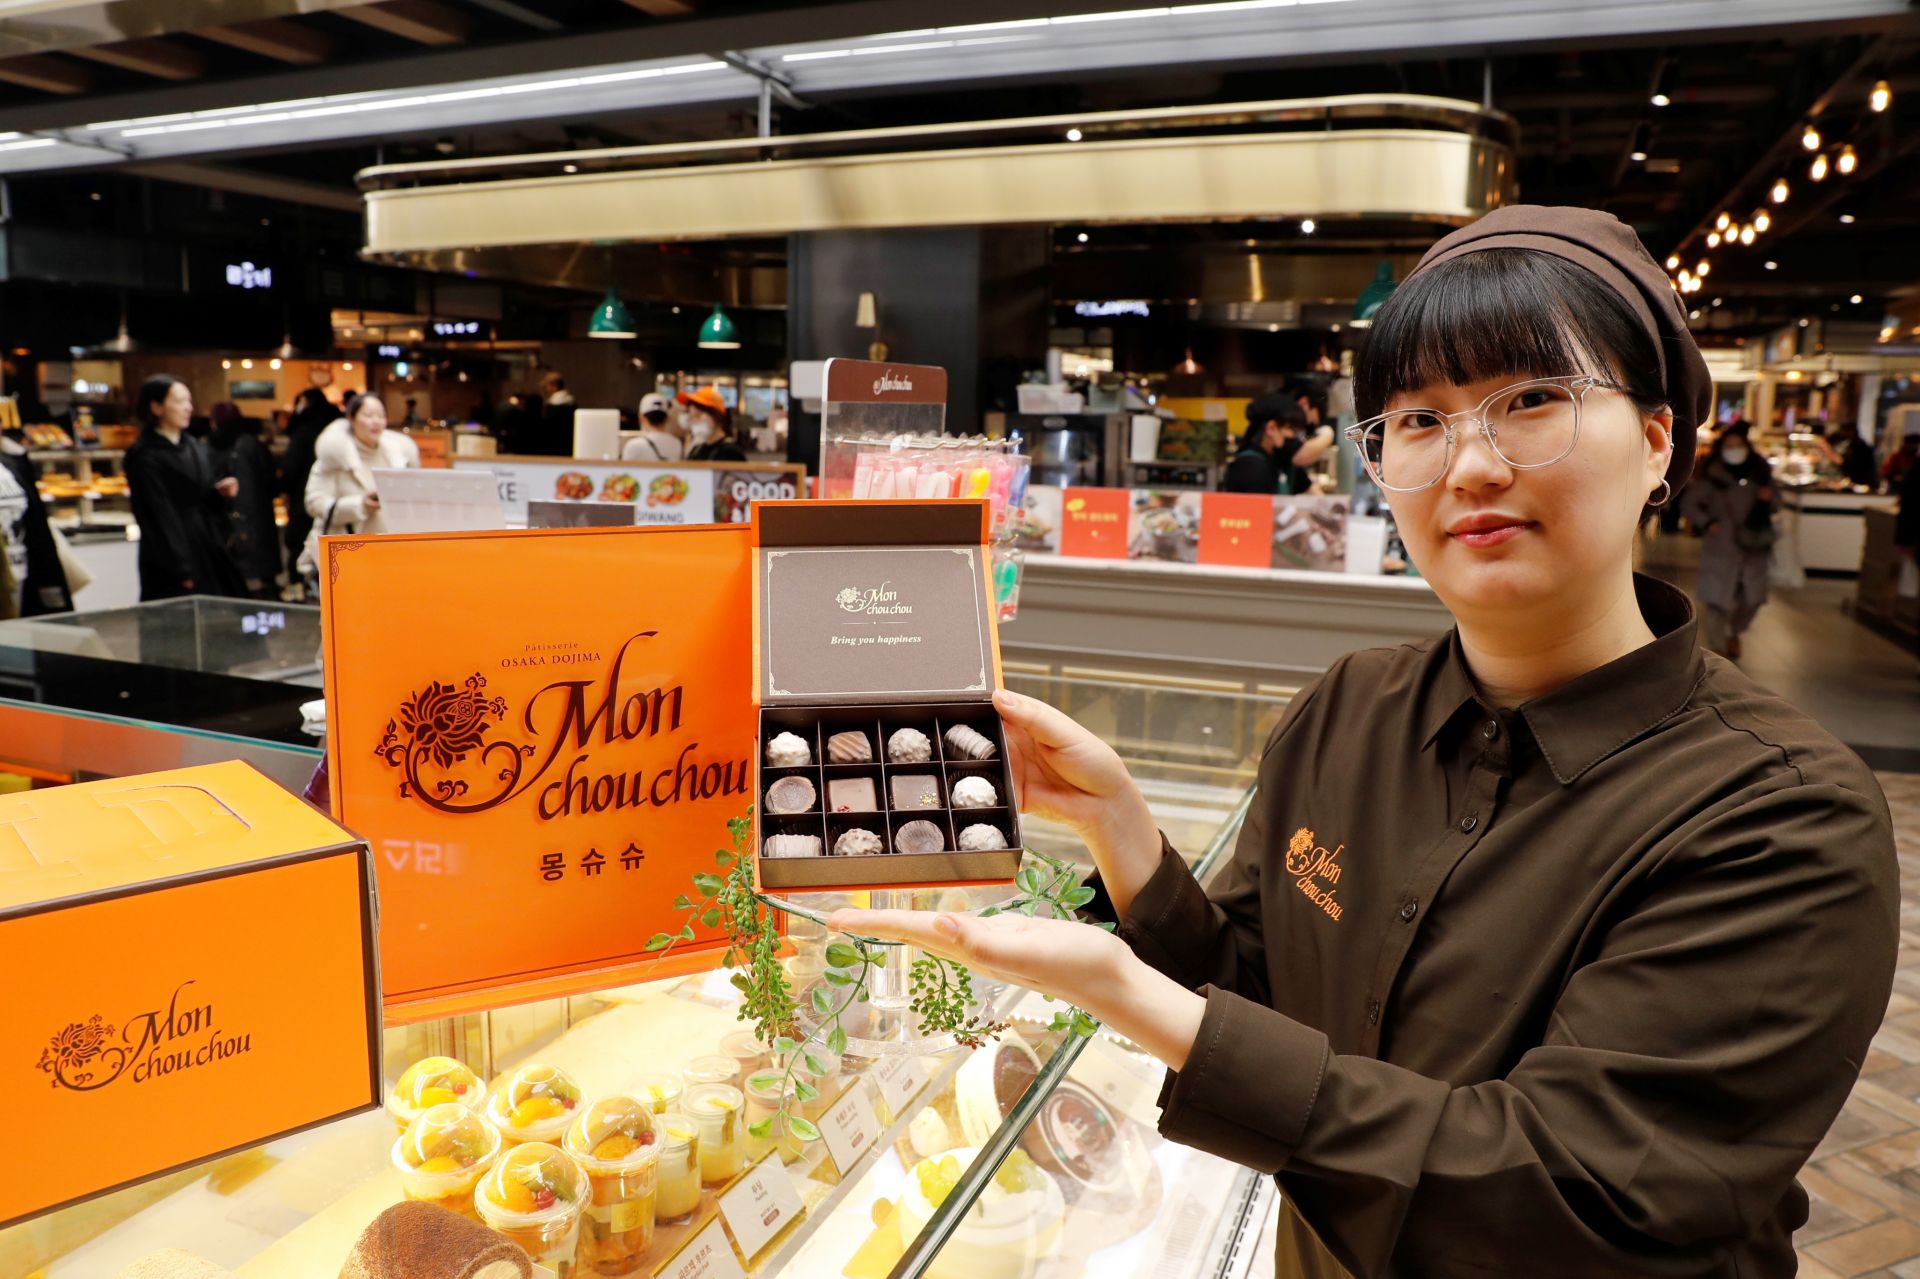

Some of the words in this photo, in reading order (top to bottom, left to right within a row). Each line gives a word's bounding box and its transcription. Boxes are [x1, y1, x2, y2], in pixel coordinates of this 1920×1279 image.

[731, 481, 797, 502] GOOD
[863, 580, 897, 603] Mon
[831, 635, 856, 646] Bring
[857, 637, 875, 646] you
[877, 634, 922, 645] happiness
[501, 656, 546, 668] OSAKA
[552, 652, 601, 665] DOJIMA
[523, 631, 683, 752] Mon
[1309, 845, 1344, 884] Mon
[121, 979, 212, 1047] Mon
